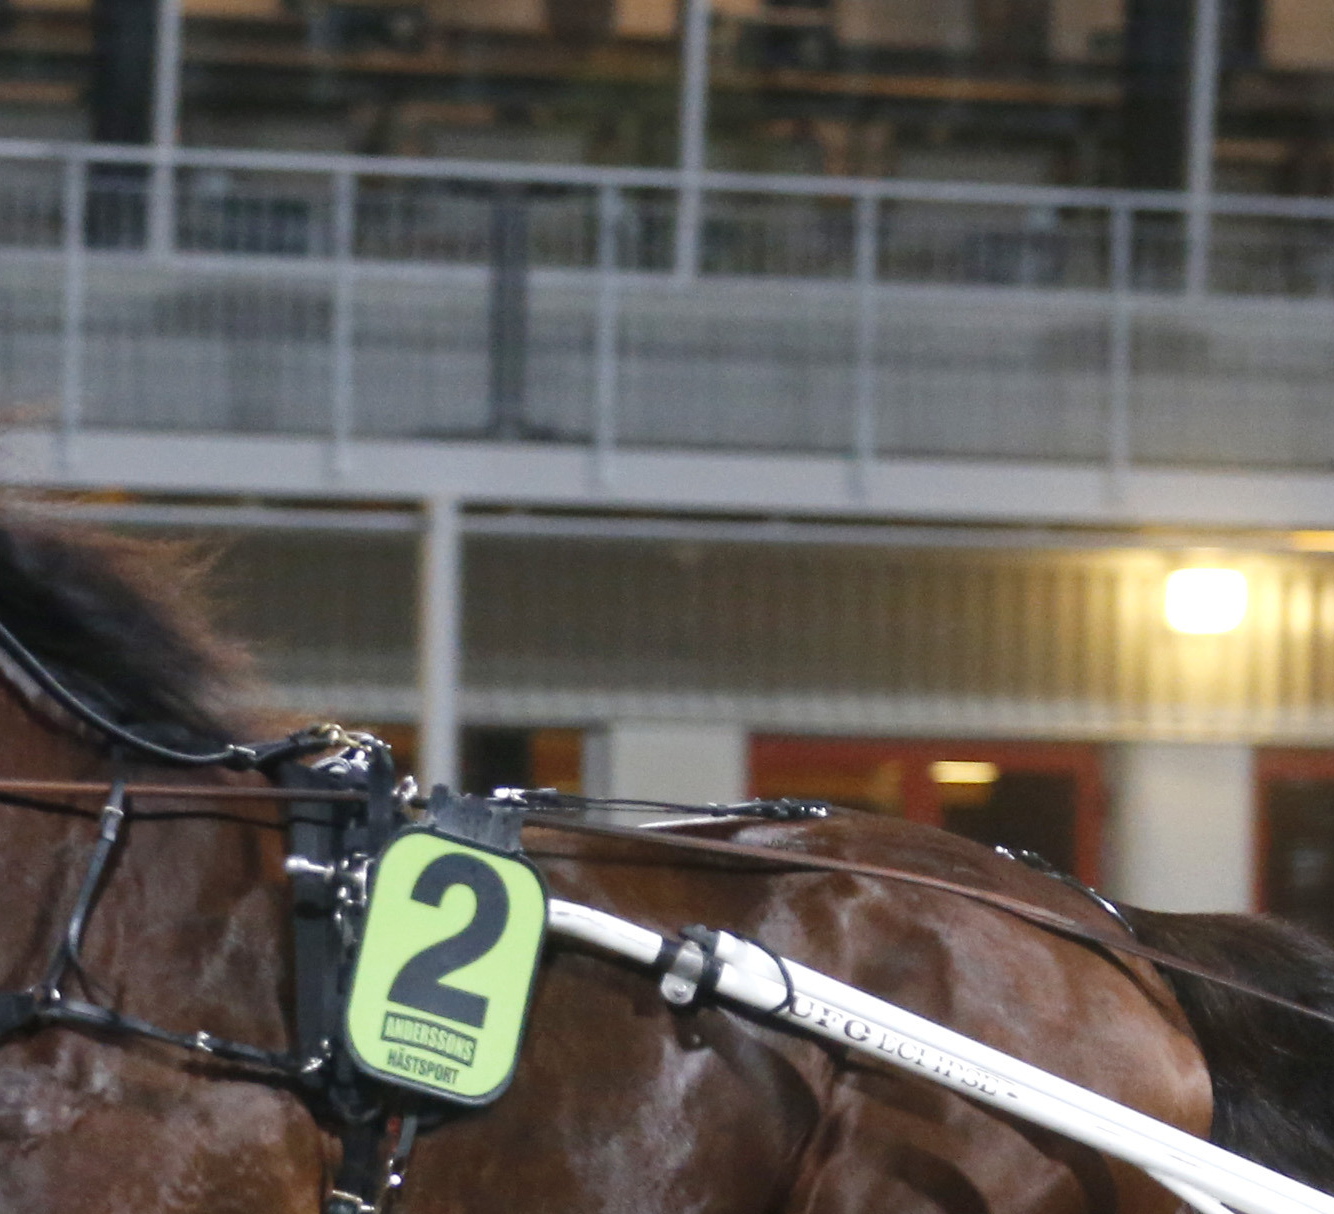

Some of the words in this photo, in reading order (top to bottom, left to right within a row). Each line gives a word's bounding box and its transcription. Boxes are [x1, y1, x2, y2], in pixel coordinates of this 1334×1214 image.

[387, 852, 510, 1030] 2
[383, 1013, 477, 1064] ANDERSSONS
[386, 1045, 460, 1085] HÄSTSPORT
